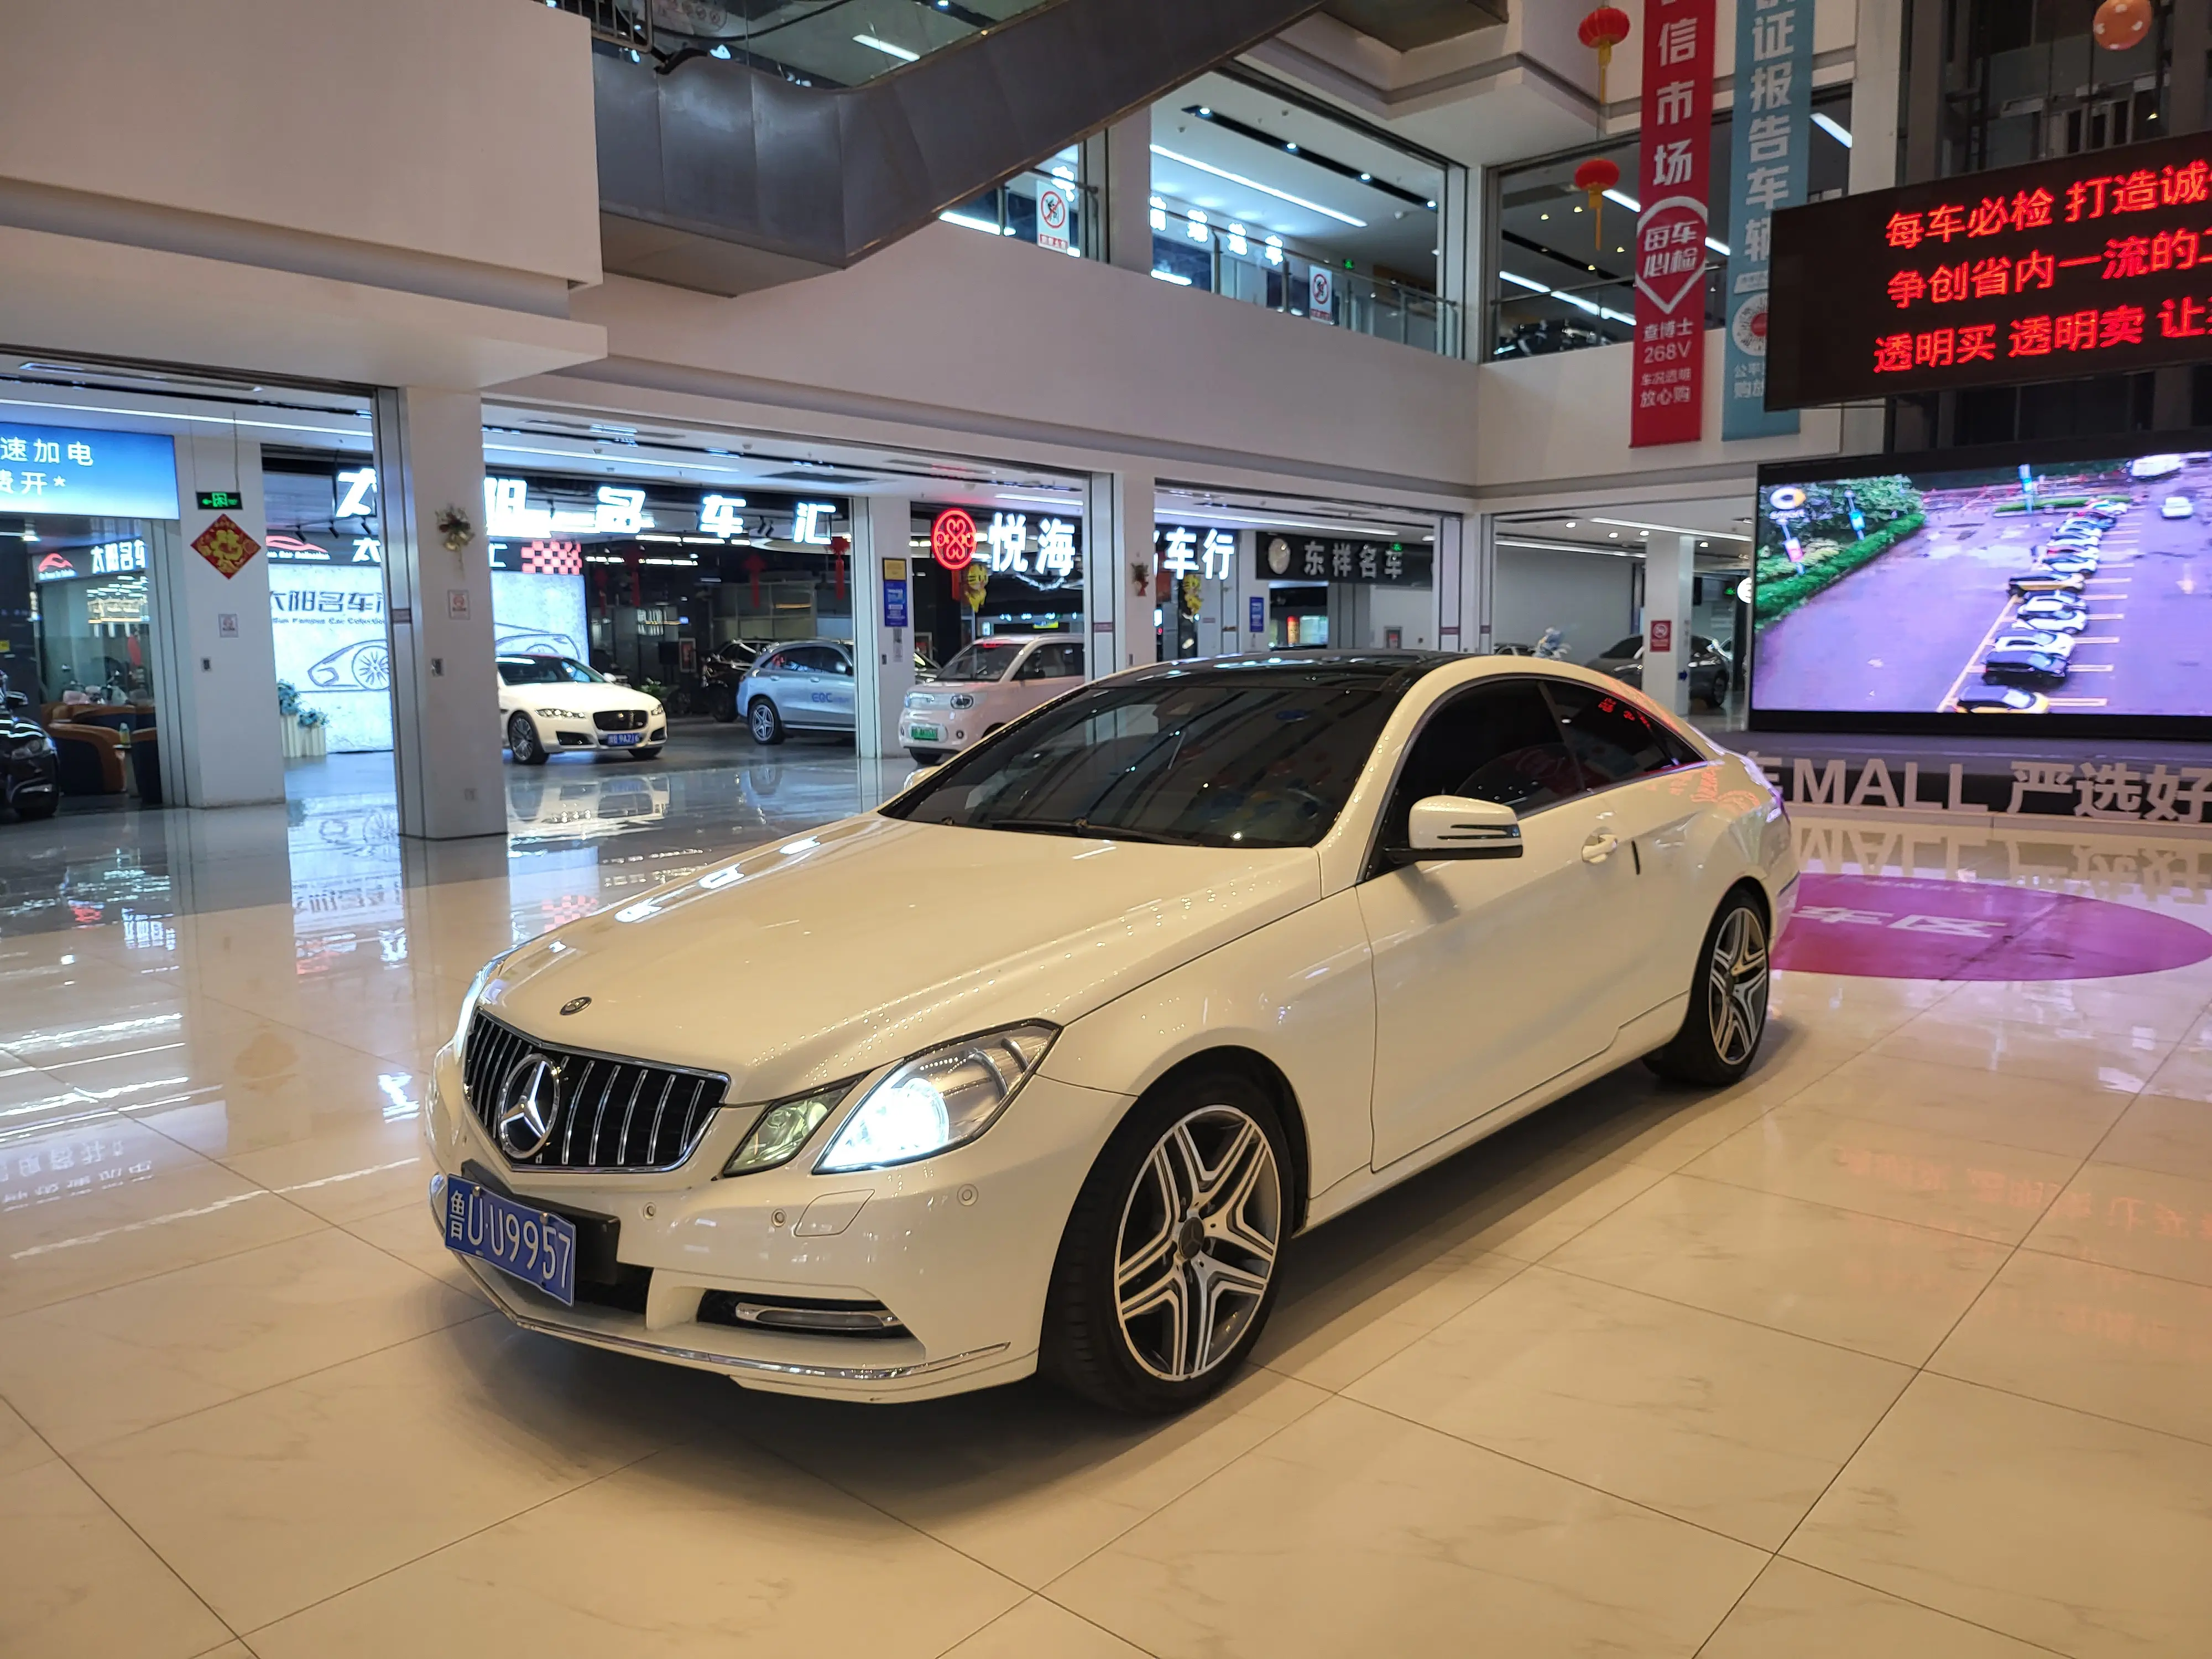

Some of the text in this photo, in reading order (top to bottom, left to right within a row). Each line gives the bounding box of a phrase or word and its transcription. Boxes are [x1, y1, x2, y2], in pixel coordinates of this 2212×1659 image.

[1652, 0, 1698, 186] 信市场
[1743, 0, 1796, 263] 证报告车辆
[1885, 158, 2212, 249] 每车必检 打造诚
[1644, 340, 1692, 364] 268V
[1873, 296, 2212, 374] 透明买 透明卖 让
[1640, 385, 1691, 408] 放心购
[0, 436, 93, 466] 速加电
[987, 512, 1235, 581] 悦海 车行
[1303, 540, 1403, 581] 东祥名车
